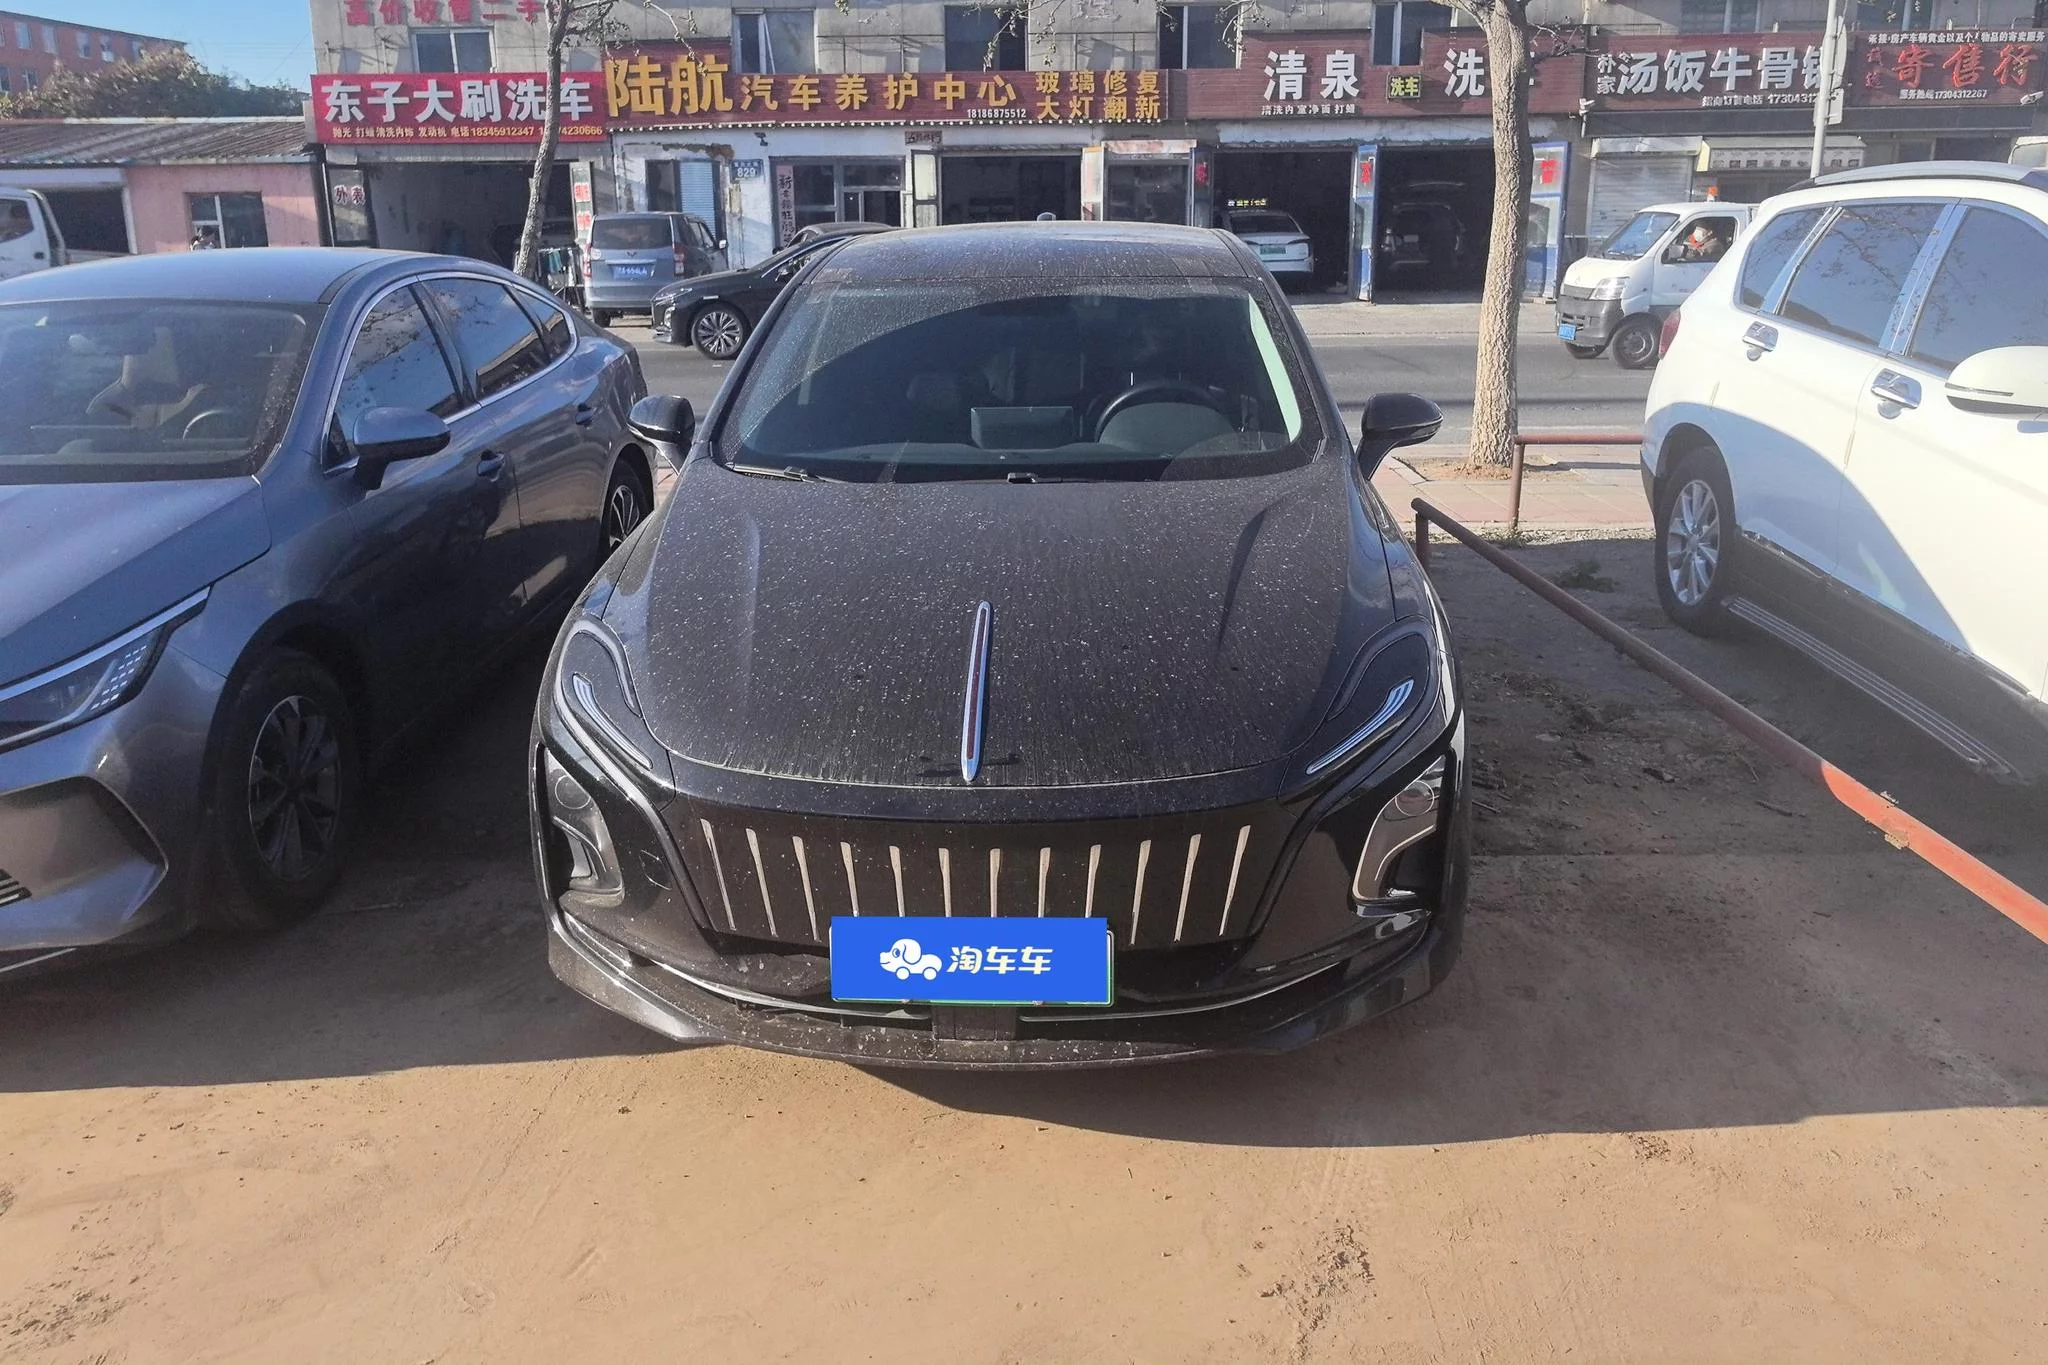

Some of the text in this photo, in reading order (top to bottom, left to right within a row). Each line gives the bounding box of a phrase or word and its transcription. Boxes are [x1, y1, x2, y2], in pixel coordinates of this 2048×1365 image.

[1036, 69, 1161, 94] 玻璃修复
[1263, 49, 1360, 100] 清泉
[1892, 43, 2040, 88] 寄售行
[321, 78, 594, 123] 东子大刷洗车
[604, 54, 733, 117] 陆航
[740, 72, 1017, 111] 汽车养护中心
[1391, 76, 1419, 96] 洗车
[967, 108, 1027, 119] 18186875512
[1036, 95, 1161, 120] 大灯翻新
